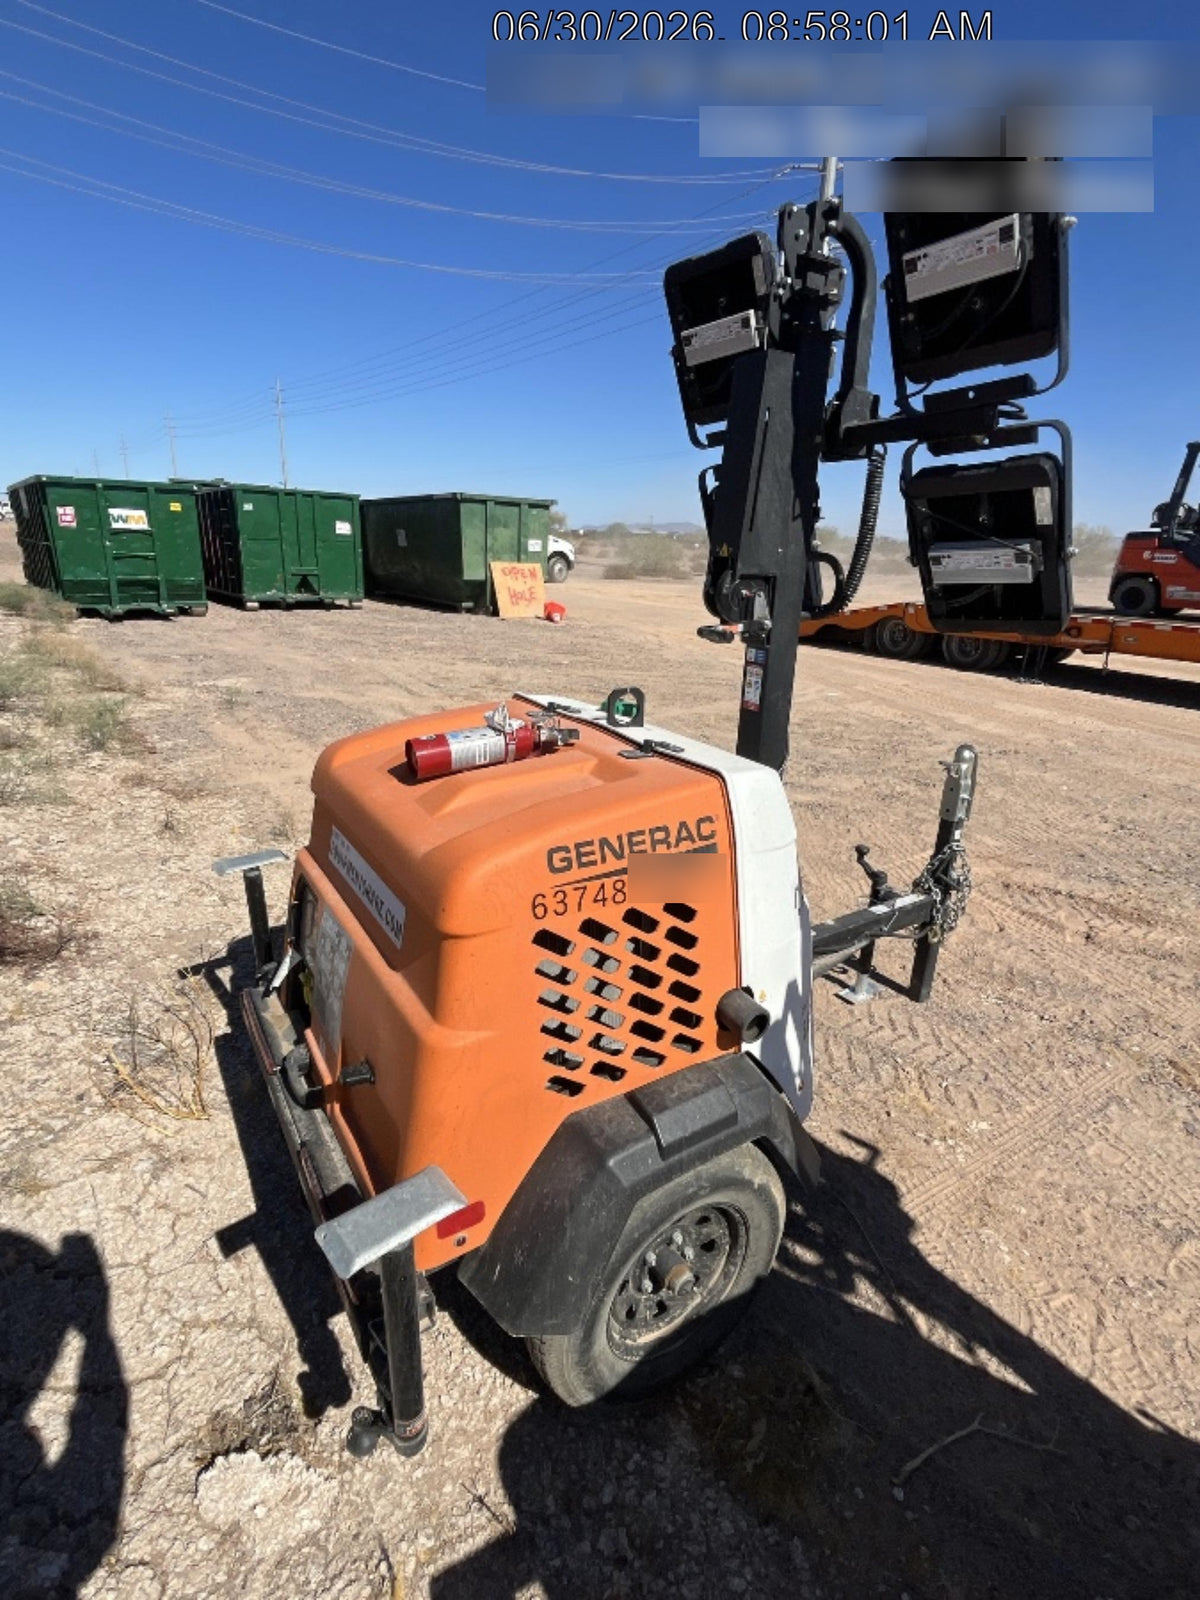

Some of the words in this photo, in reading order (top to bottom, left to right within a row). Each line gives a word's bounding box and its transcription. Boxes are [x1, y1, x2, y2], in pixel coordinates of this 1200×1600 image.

[109, 513, 146, 526] WM
[501, 565, 538, 581] OPEN
[547, 815, 717, 875] GENERAC
[531, 879, 628, 920] 63748
